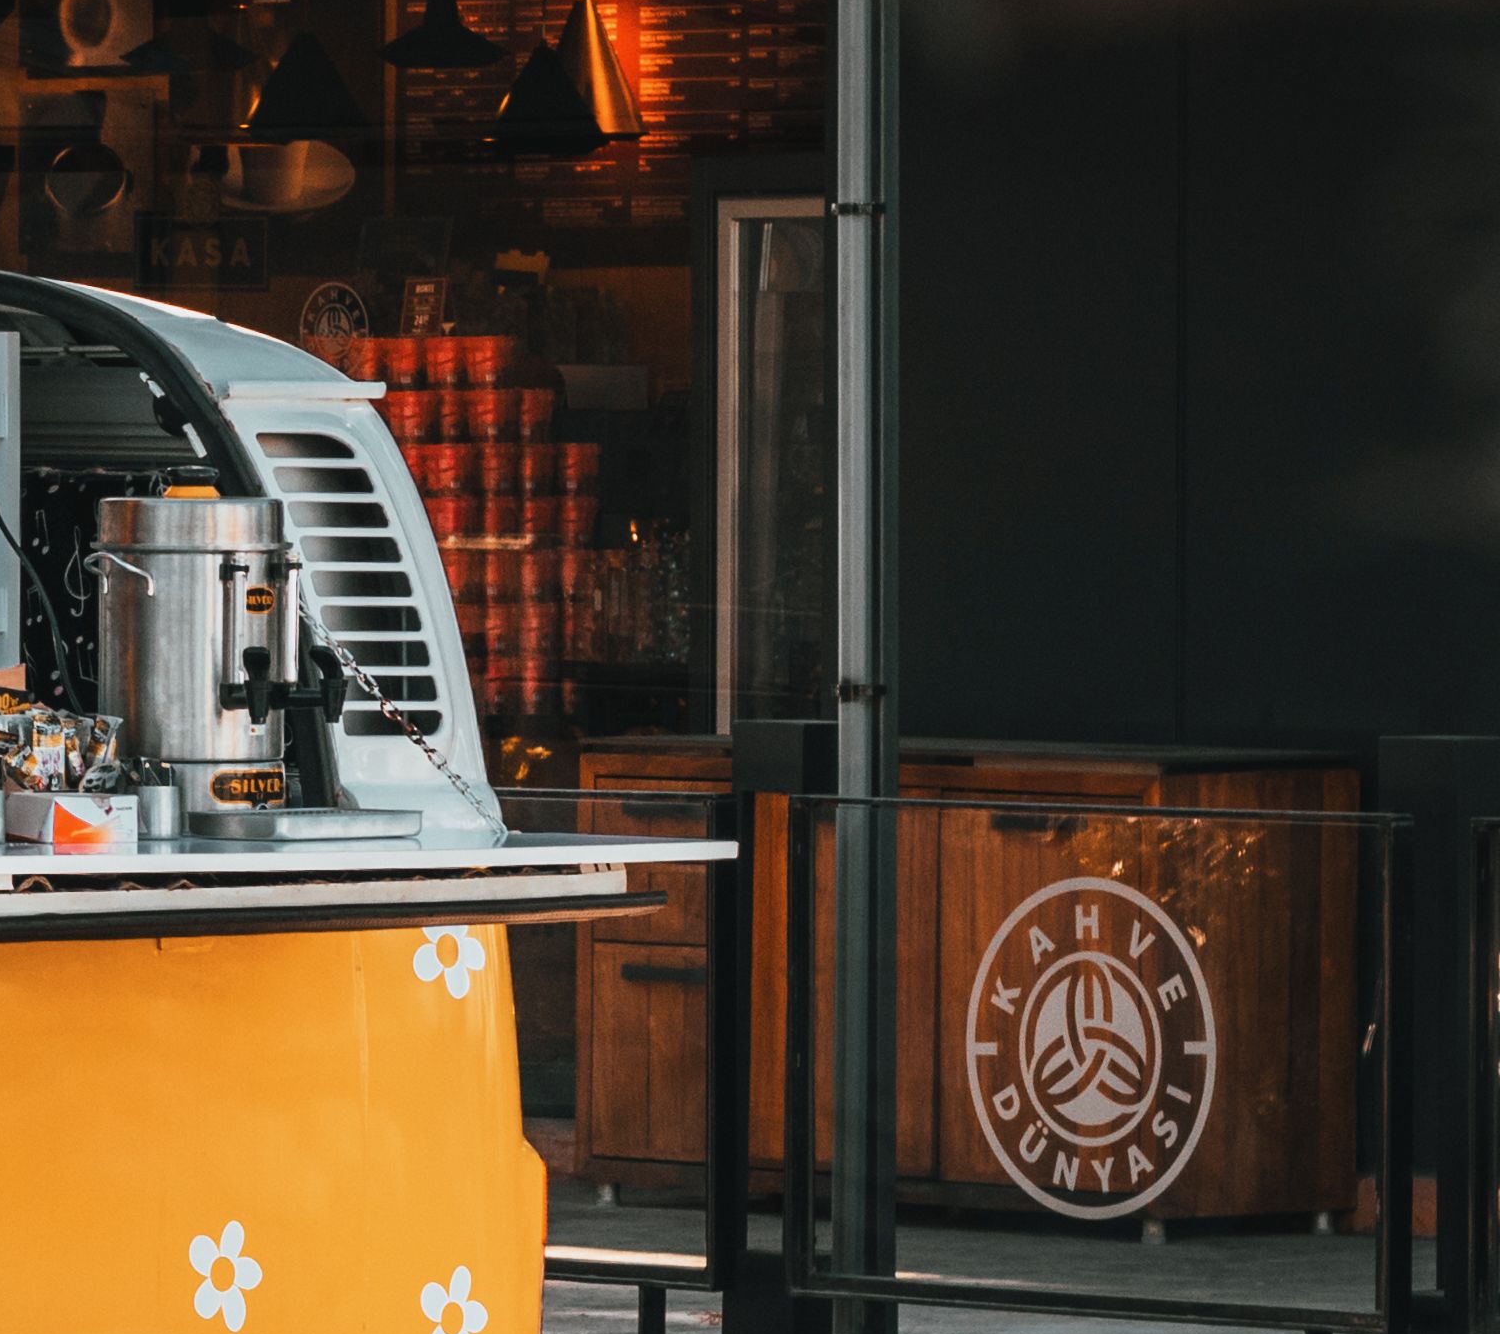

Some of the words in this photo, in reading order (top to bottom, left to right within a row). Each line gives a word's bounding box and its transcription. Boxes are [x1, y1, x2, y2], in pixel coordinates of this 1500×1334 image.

[230, 778, 281, 795] SILVER
[989, 903, 1188, 1016] KAHVE
[991, 1082, 1193, 1194] DÜNYASI
